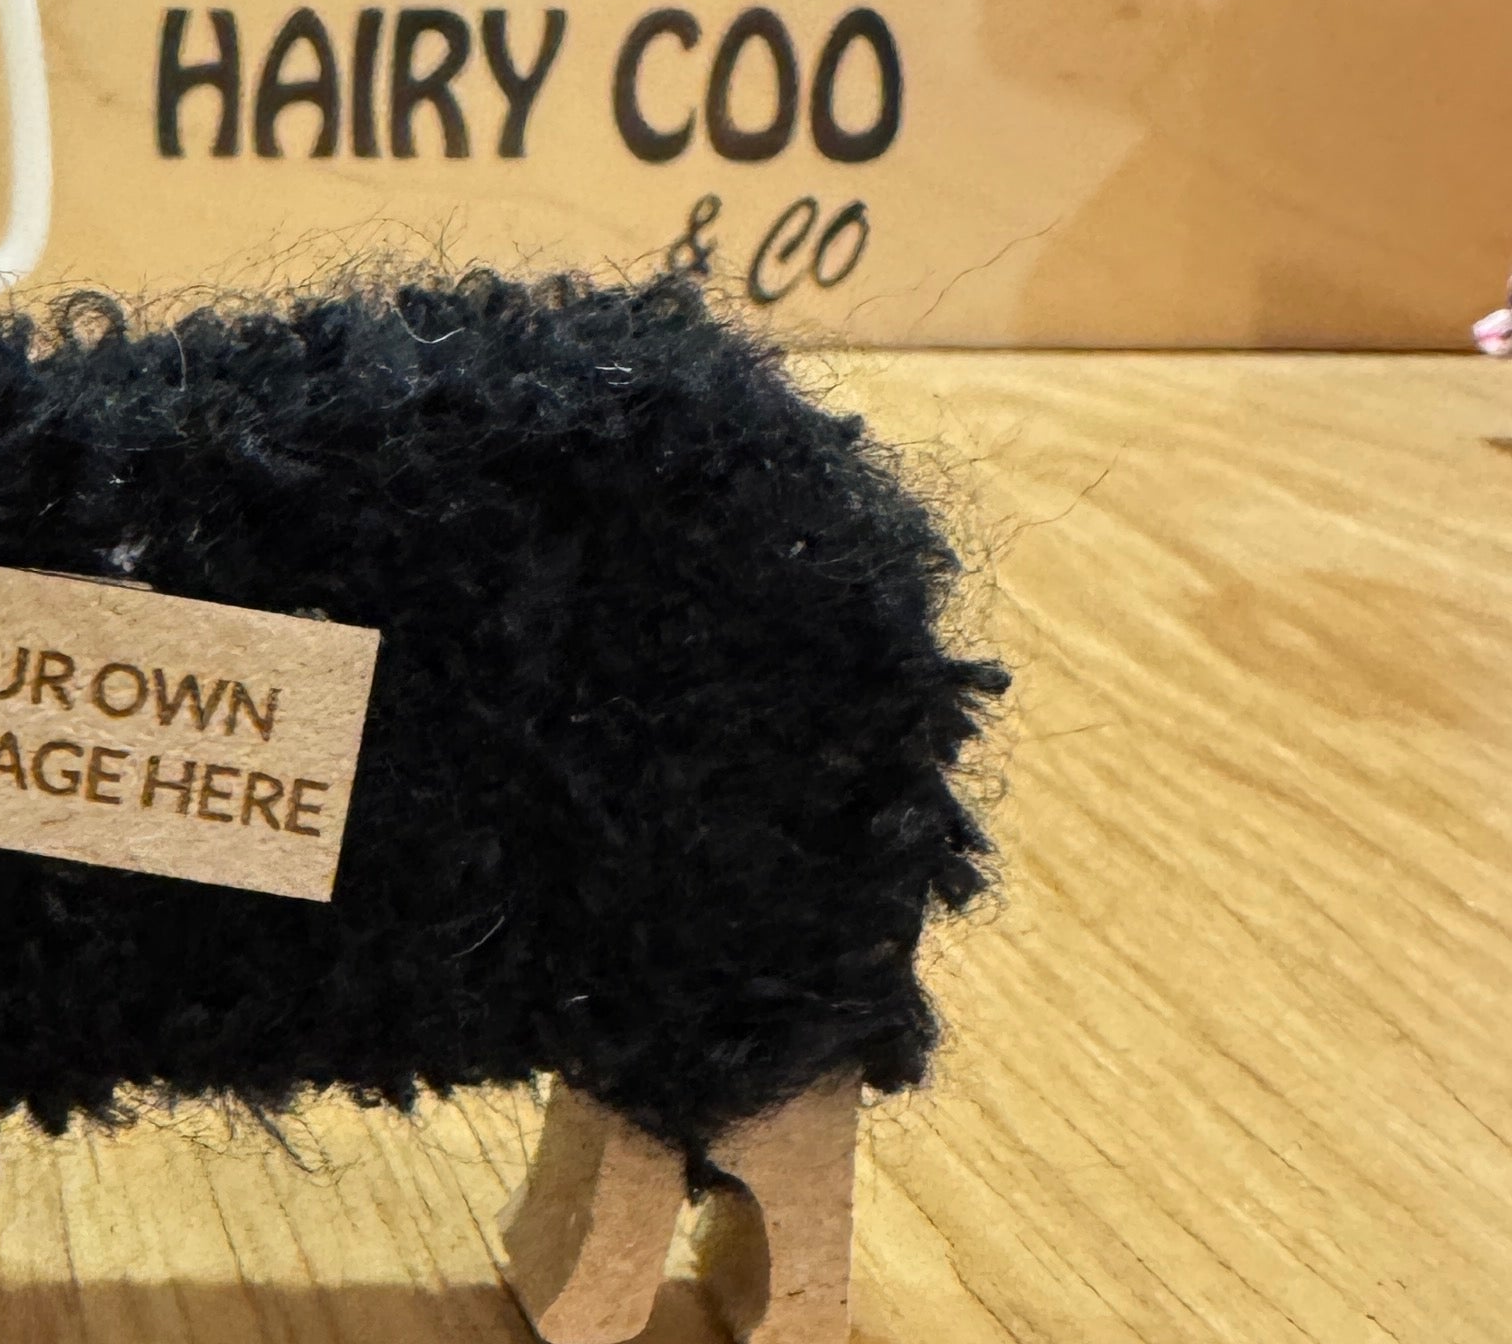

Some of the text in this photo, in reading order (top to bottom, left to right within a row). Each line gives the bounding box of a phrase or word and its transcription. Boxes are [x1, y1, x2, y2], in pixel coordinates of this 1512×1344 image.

[156, 5, 904, 164] HAIRY COO
[672, 193, 870, 304] & CO
[92, 663, 281, 741] OWN
[141, 755, 329, 837] HERE
